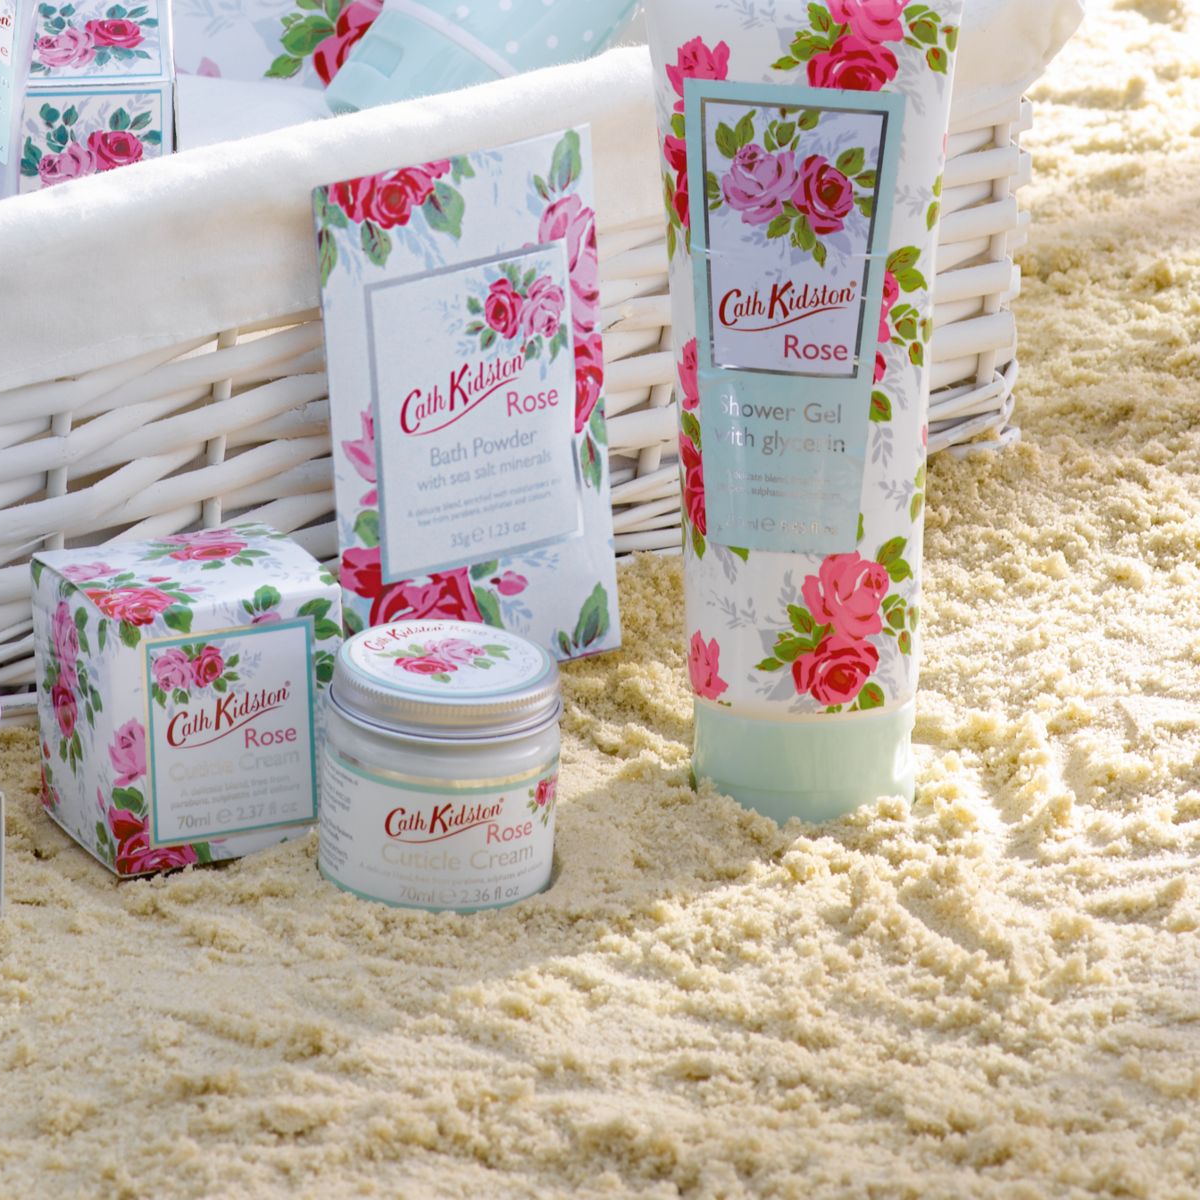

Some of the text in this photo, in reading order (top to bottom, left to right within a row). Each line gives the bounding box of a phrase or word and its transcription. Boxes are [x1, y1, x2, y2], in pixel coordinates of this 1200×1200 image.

[718, 280, 855, 327] Cath Kidston
[784, 334, 848, 361] Rose
[400, 355, 525, 434] Cath Kidston
[506, 388, 559, 417] Rose
[720, 394, 843, 425] Shower Gel
[430, 428, 539, 467] Bath Powder
[714, 426, 755, 449] with
[417, 450, 552, 492] with sea salt minerals
[450, 531, 471, 548] 35g
[488, 522, 510, 538] 1.23
[513, 521, 527, 533] oz
[166, 687, 290, 747] Cath Kidston
[244, 727, 297, 749] Rose
[238, 749, 300, 772] Cream
[252, 787, 268, 796] and
[270, 775, 290, 783] from
[177, 812, 211, 829] 70ml
[236, 804, 265, 821] 2.37
[281, 801, 298, 813] oz
[384, 802, 502, 837] Cath Kidston
[486, 821, 533, 845] Rose
[381, 843, 534, 871] Cuticle Cream
[399, 884, 435, 904] 70ml
[460, 888, 490, 904] 2.36
[494, 885, 502, 901] fl
[505, 886, 519, 899] oz
